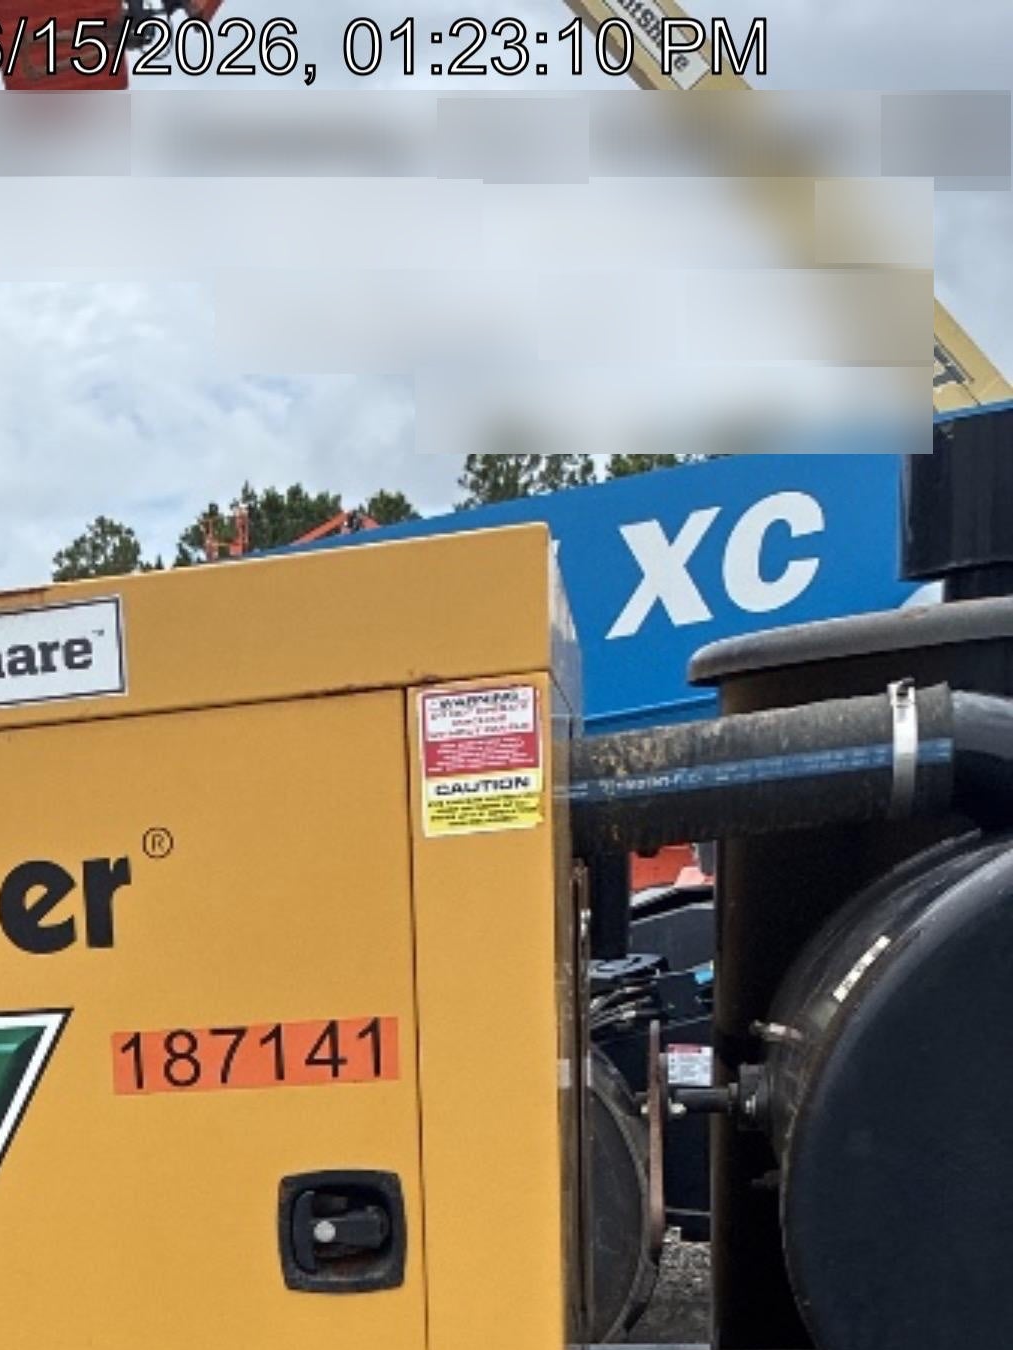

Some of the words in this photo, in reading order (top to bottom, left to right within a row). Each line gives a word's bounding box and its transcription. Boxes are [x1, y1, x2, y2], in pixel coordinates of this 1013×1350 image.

[604, 490, 826, 640] XC
[434, 775, 531, 796] CAUTION
[121, 1017, 382, 1090] 187141
